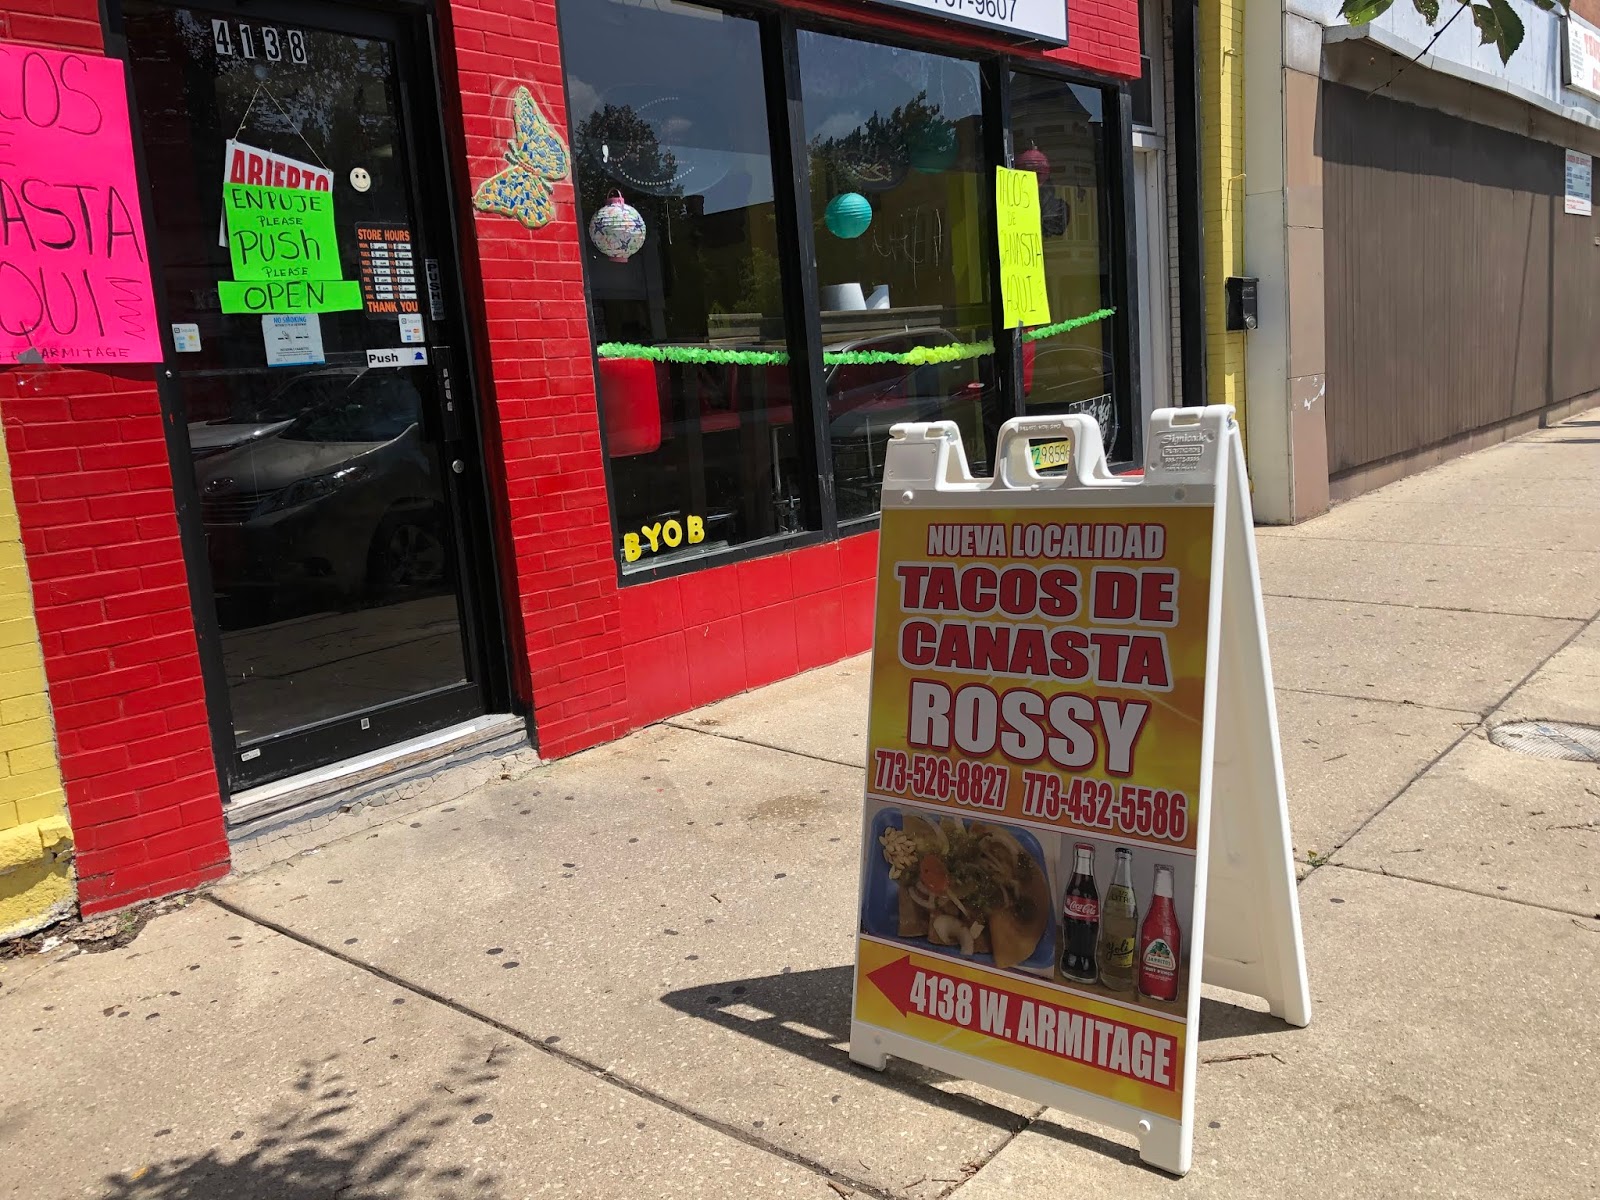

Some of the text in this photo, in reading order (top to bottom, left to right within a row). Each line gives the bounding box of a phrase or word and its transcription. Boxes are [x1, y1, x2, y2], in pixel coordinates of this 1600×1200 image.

[934, 0, 1016, 22] -9607
[214, 20, 306, 64] 4138
[232, 188, 323, 213] ENPUJE
[998, 170, 1031, 208] TACOS
[256, 215, 303, 227] PLEASE
[357, 228, 410, 241] STORE HOURS
[261, 266, 309, 279] PLEASE
[427, 263, 441, 300] PUSH
[244, 281, 324, 310] OPEN
[366, 301, 418, 312] THANK YOU
[42, 347, 131, 359] ARMITAGE
[369, 353, 399, 363] Push
[623, 515, 705, 562] BYOB
[928, 523, 1165, 559] NUEVA LOCALIDAD
[897, 565, 1175, 623] TACOS DE
[901, 620, 1169, 687] CANASTA
[909, 680, 1148, 774] ROSSY
[875, 750, 1187, 840] 773-526-8827 773-432-5586
[909, 971, 1172, 1086] 4138 W. ARMITAGE
